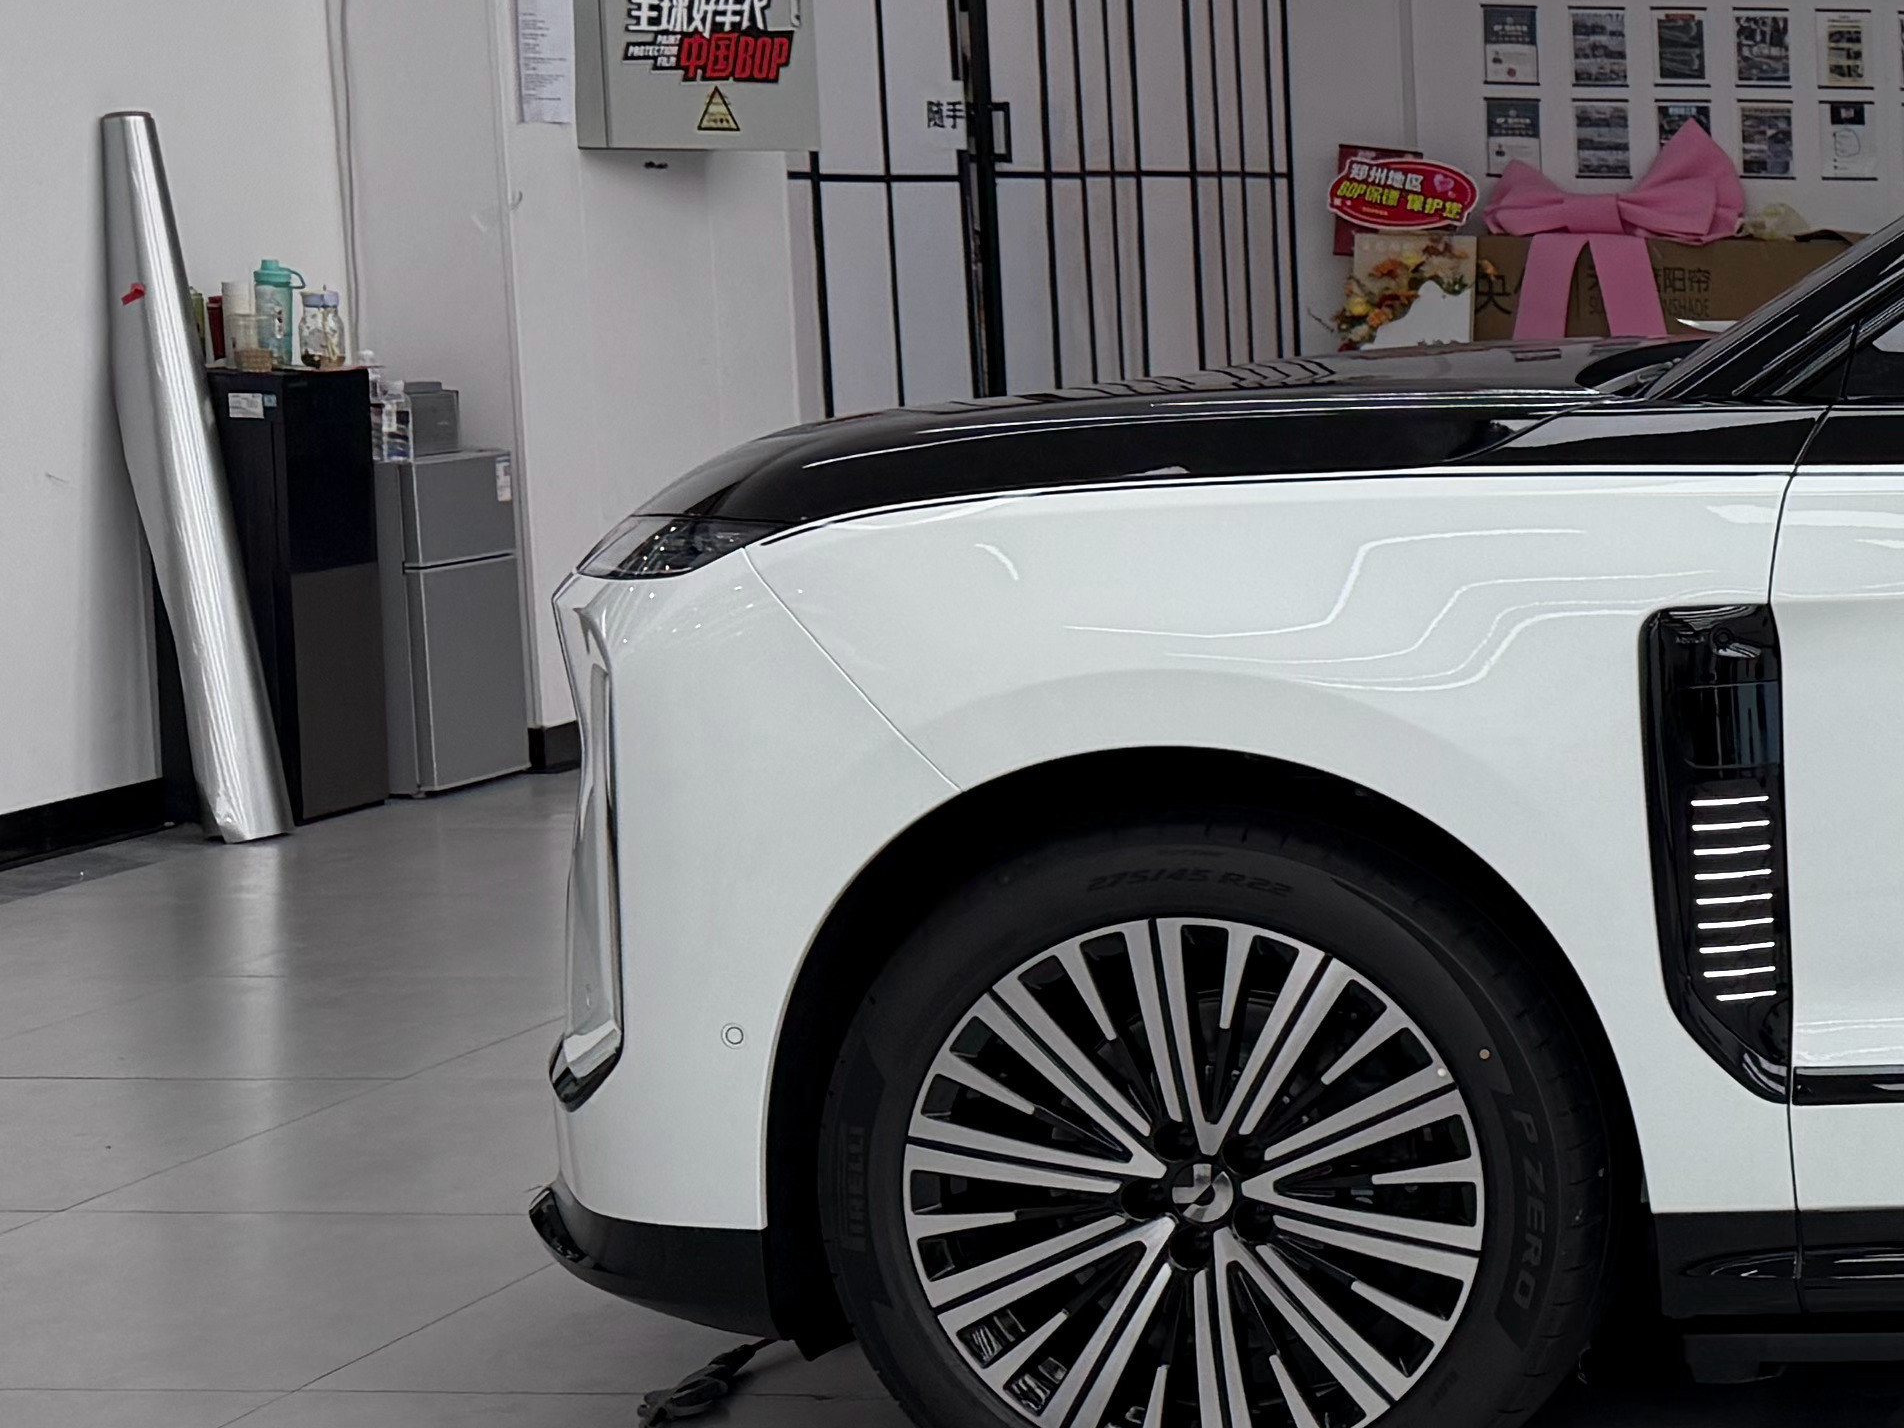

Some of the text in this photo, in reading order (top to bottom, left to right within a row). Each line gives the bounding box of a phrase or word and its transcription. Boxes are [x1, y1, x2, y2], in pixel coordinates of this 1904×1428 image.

[627, 45, 679, 57] PROTECTION
[656, 56, 677, 67] FILM
[680, 33, 789, 79] 中国BOP
[1218, 872, 1294, 897] R22
[1511, 1108, 1547, 1310] P ZERO
